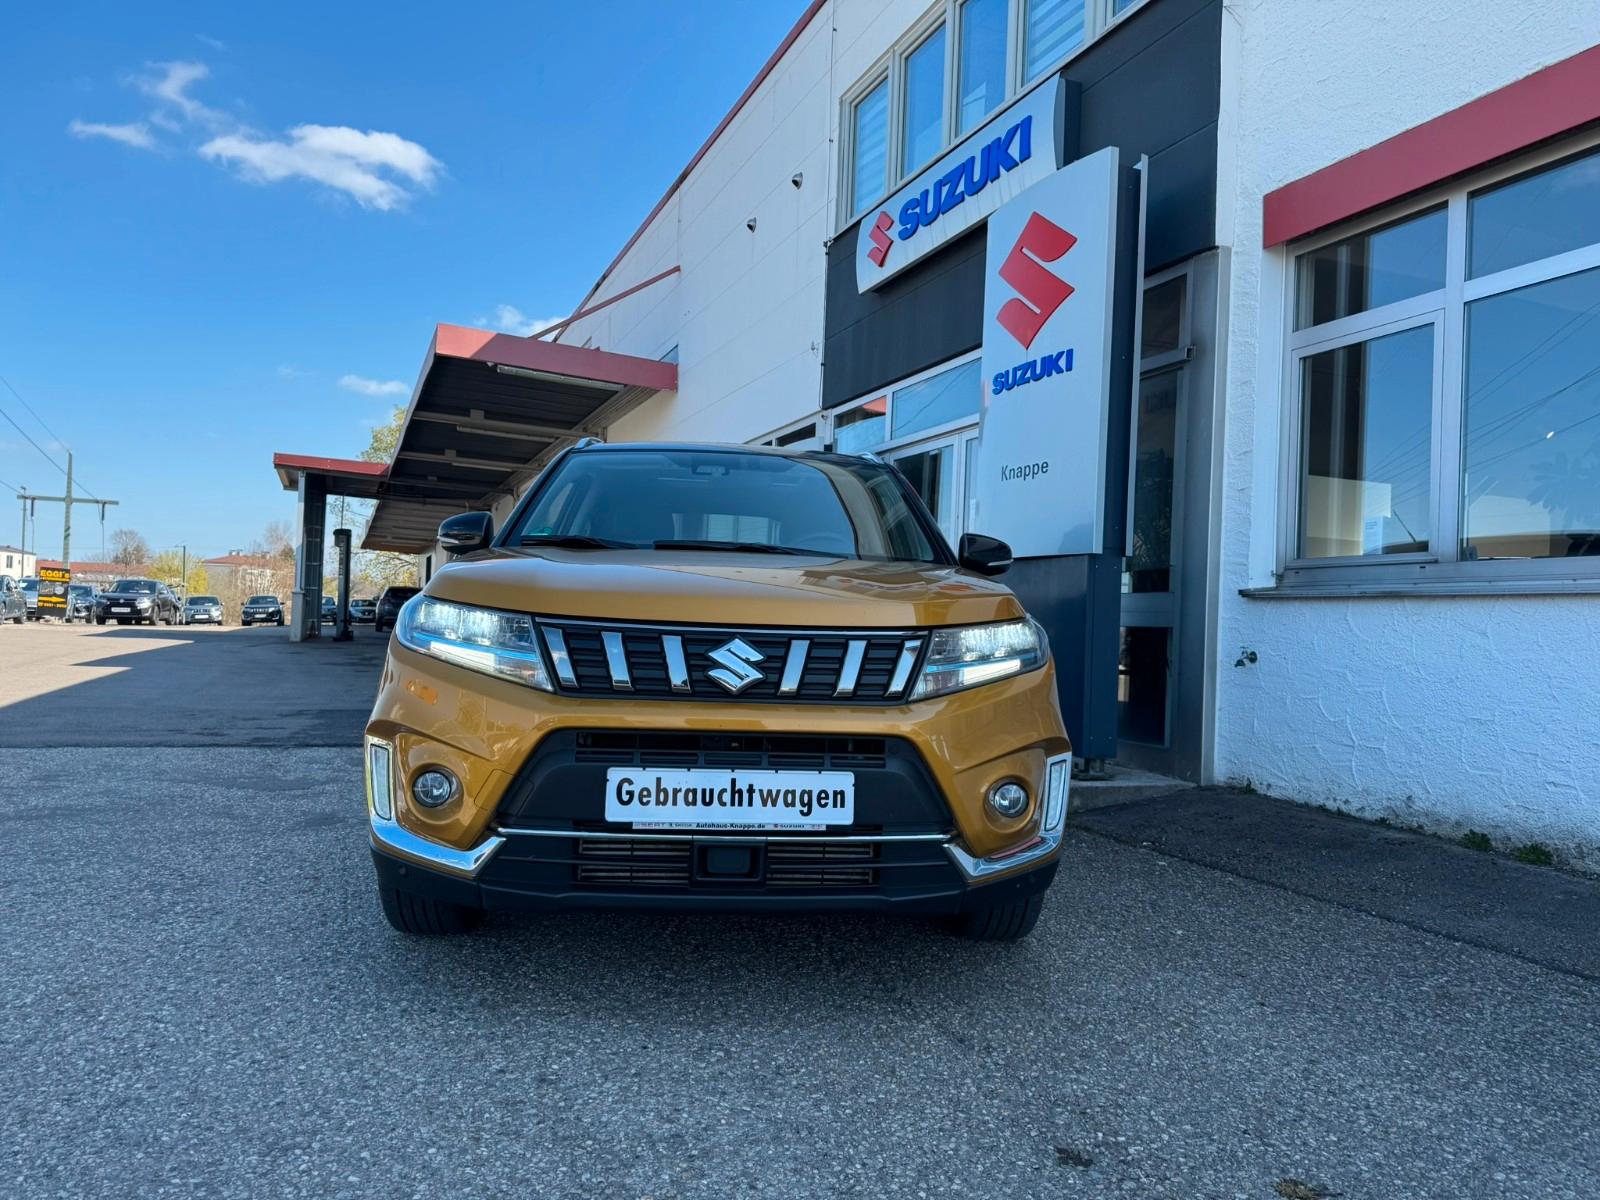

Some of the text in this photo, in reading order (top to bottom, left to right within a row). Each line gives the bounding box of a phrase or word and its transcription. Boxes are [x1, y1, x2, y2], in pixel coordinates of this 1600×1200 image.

[898, 115, 1032, 240] SUZUKI
[992, 348, 1074, 395] SUZUKI
[1001, 461, 1049, 481] Knappe
[616, 777, 846, 817] Gebrauchtwagen
